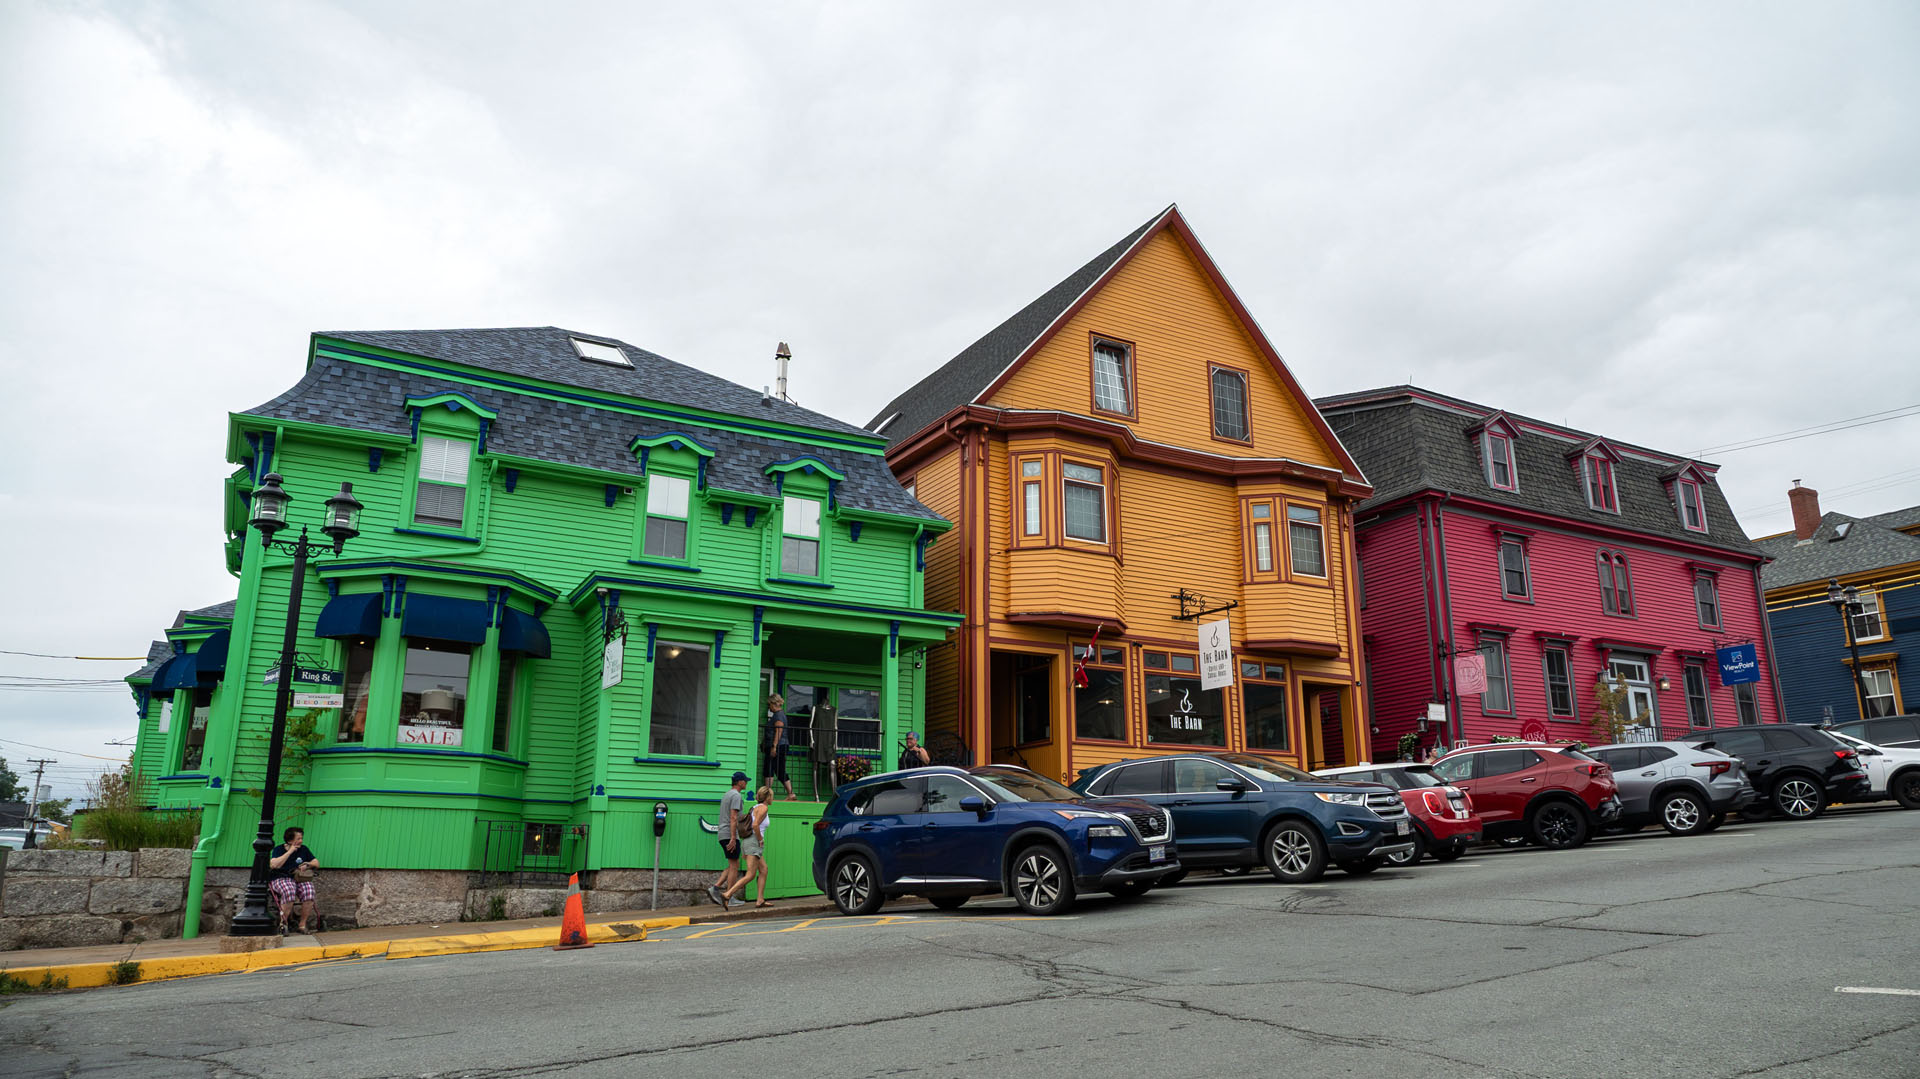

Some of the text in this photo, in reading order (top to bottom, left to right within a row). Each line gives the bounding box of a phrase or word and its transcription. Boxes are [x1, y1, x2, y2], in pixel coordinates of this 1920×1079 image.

[1203, 650, 1228, 664] THE BARN
[1722, 661, 1754, 671] ViewPoint
[301, 671, 332, 682] King St.
[1170, 714, 1203, 730] THE BARN
[405, 729, 455, 745] SALE
[1061, 772, 1068, 783] 9
